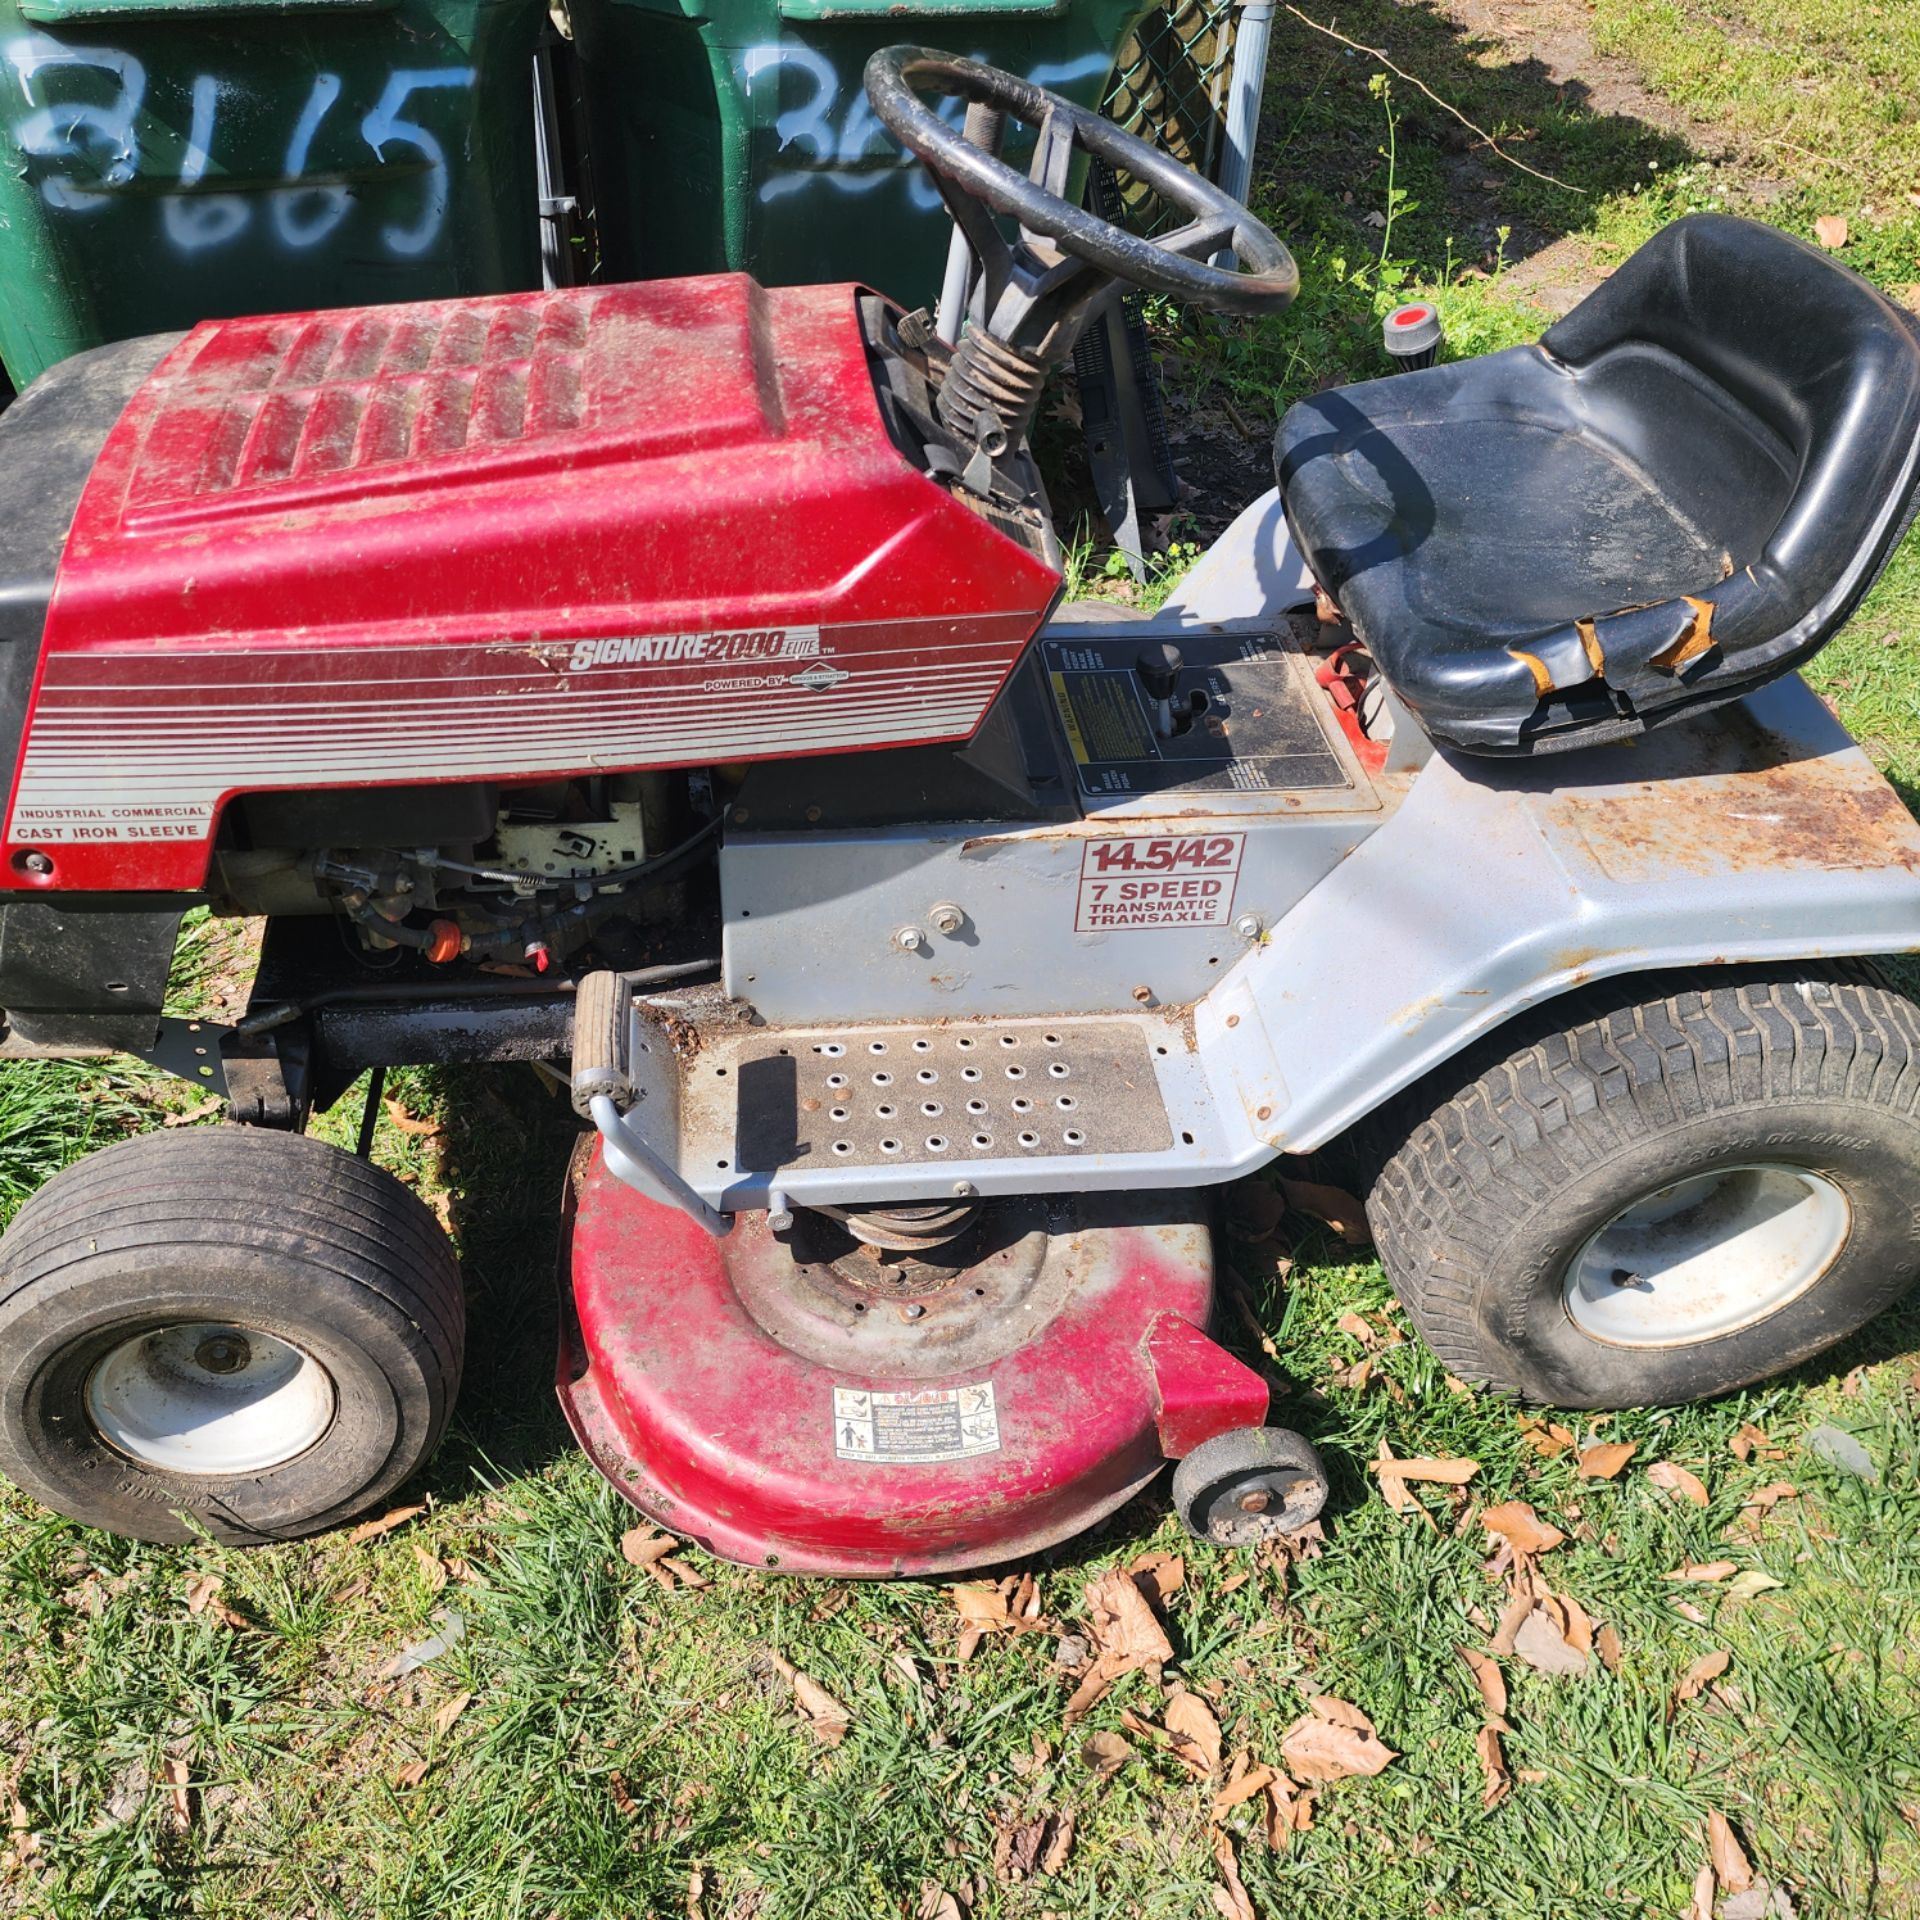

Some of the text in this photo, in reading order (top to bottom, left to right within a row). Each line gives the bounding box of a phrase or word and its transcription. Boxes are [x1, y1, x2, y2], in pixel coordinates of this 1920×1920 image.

[705, 676, 784, 690] POWERED BY
[1057, 692, 1076, 730] WARNING
[20, 806, 206, 819] INDUSTRIAL COMMERCIAL
[16, 825, 199, 839] CAST IRON SLEEVE
[1092, 837, 1234, 872] 14.5/42
[1091, 879, 1222, 901] 7 SPEED
[1089, 899, 1218, 914] TRANSMATIC
[1088, 910, 1216, 926] TRANSAXLE
